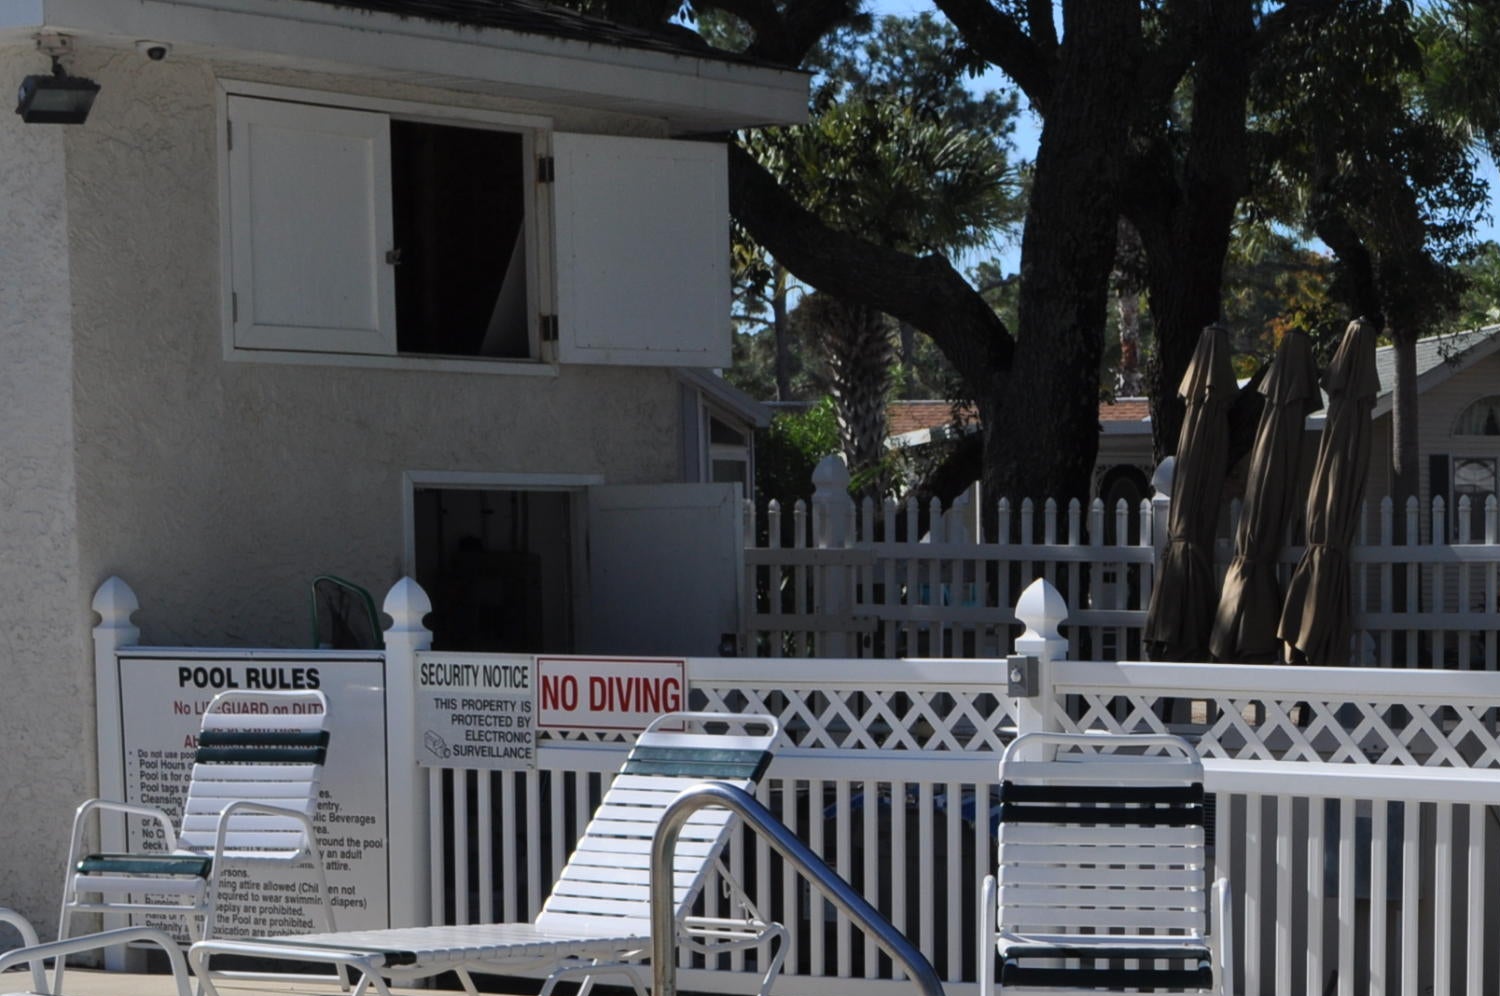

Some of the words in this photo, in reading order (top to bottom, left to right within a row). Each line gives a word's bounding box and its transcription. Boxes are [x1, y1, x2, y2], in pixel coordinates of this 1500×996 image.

[178, 666, 239, 689] POOL
[246, 667, 321, 690] RULES
[420, 662, 480, 687] SECURITY
[482, 664, 529, 689] NOTICE
[541, 675, 579, 711] NO
[589, 676, 681, 713] DIVING
[174, 701, 191, 715] No
[434, 698, 458, 710] THIS
[461, 699, 516, 712] PROPERTY
[521, 701, 531, 712] IS
[451, 714, 514, 727] PROTECTED
[517, 716, 531, 728] BY
[465, 730, 532, 743] ELECTRONIC
[453, 745, 532, 759] SURVEILLANCE
[140, 759, 158, 769] Pool
[161, 760, 186, 769] Hours
[140, 771, 159, 780] Pool
[161, 771, 168, 781] is
[170, 772, 182, 781] for
[140, 782, 159, 792] Pool
[161, 784, 180, 796] tags
[141, 793, 182, 805] Cleansing
[329, 812, 377, 826] Beverages
[346, 838, 361, 848] the
[363, 839, 383, 850] pool
[326, 850, 338, 859] an
[340, 849, 363, 859] adult
[239, 880, 261, 890] attire
[263, 881, 296, 892] allowed
[341, 886, 356, 895] not
[217, 892, 248, 902] equired
[251, 893, 260, 902] to
[262, 896, 282, 904] wear
[331, 897, 367, 909] diapers)
[243, 905, 257, 914] are
[217, 914, 230, 923] the
[232, 914, 251, 925] Pool
[253, 917, 267, 926] are
[269, 917, 316, 929] prohibited.
